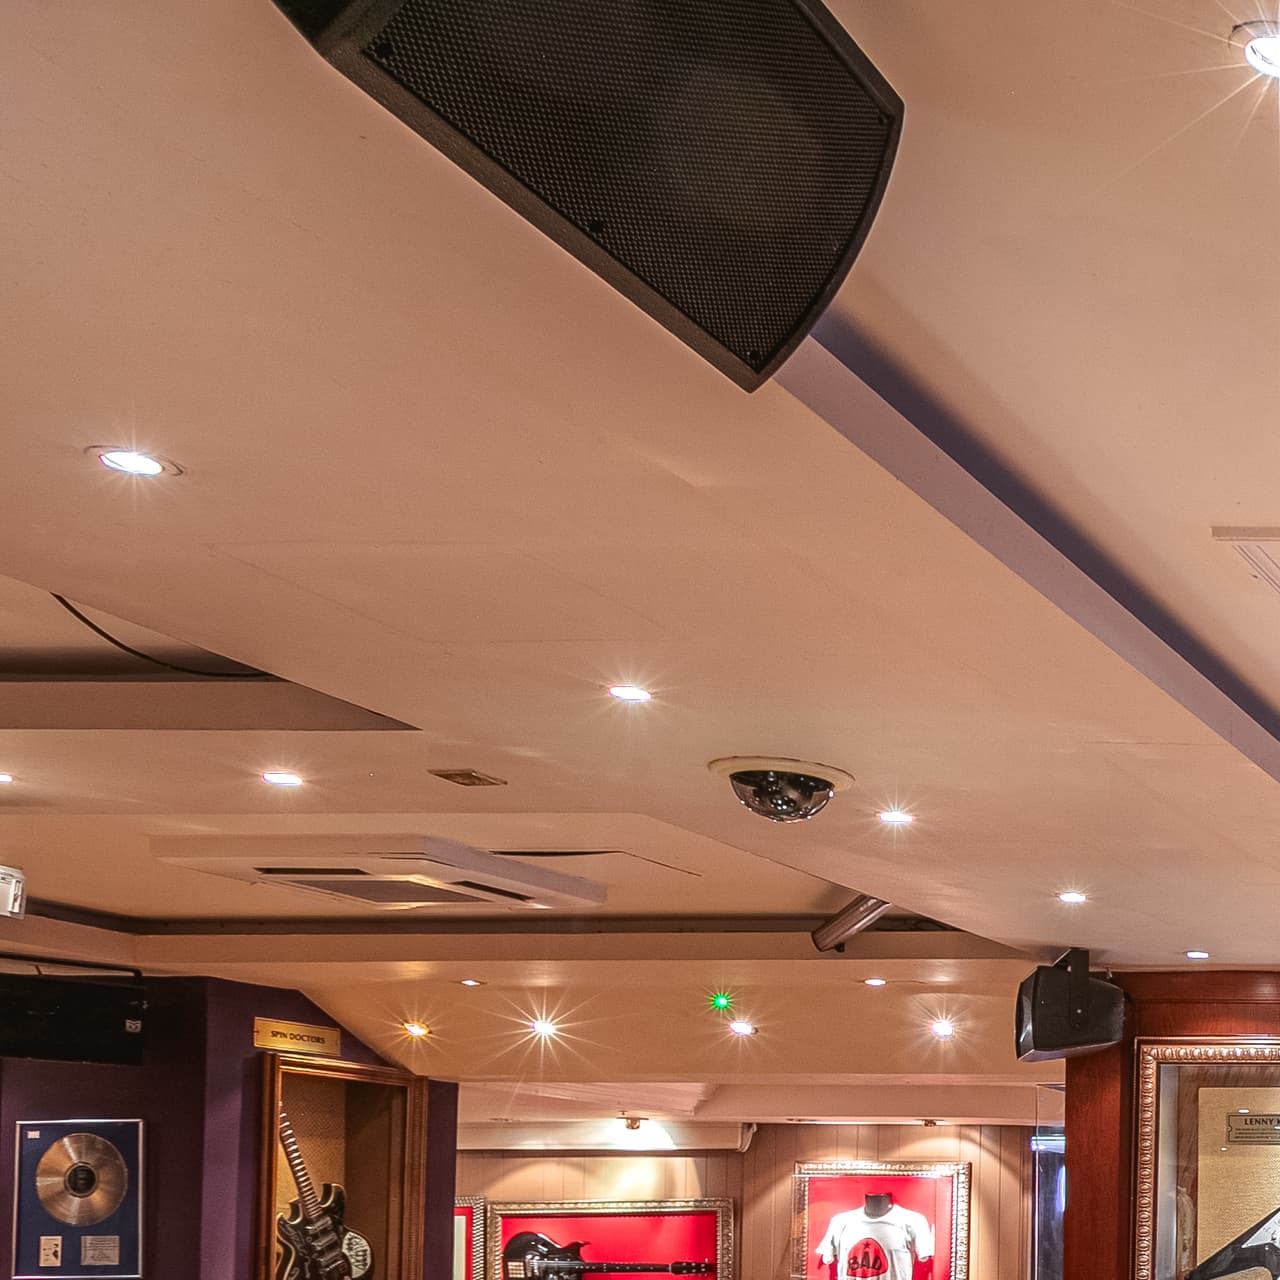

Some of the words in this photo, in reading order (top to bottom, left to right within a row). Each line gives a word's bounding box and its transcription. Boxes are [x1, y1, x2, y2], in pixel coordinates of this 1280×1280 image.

[271, 1030, 288, 1039] SPIN
[289, 1033, 326, 1044] DOCTORS
[1244, 1118, 1274, 1126] LENNY
[847, 1251, 883, 1271] BAD
